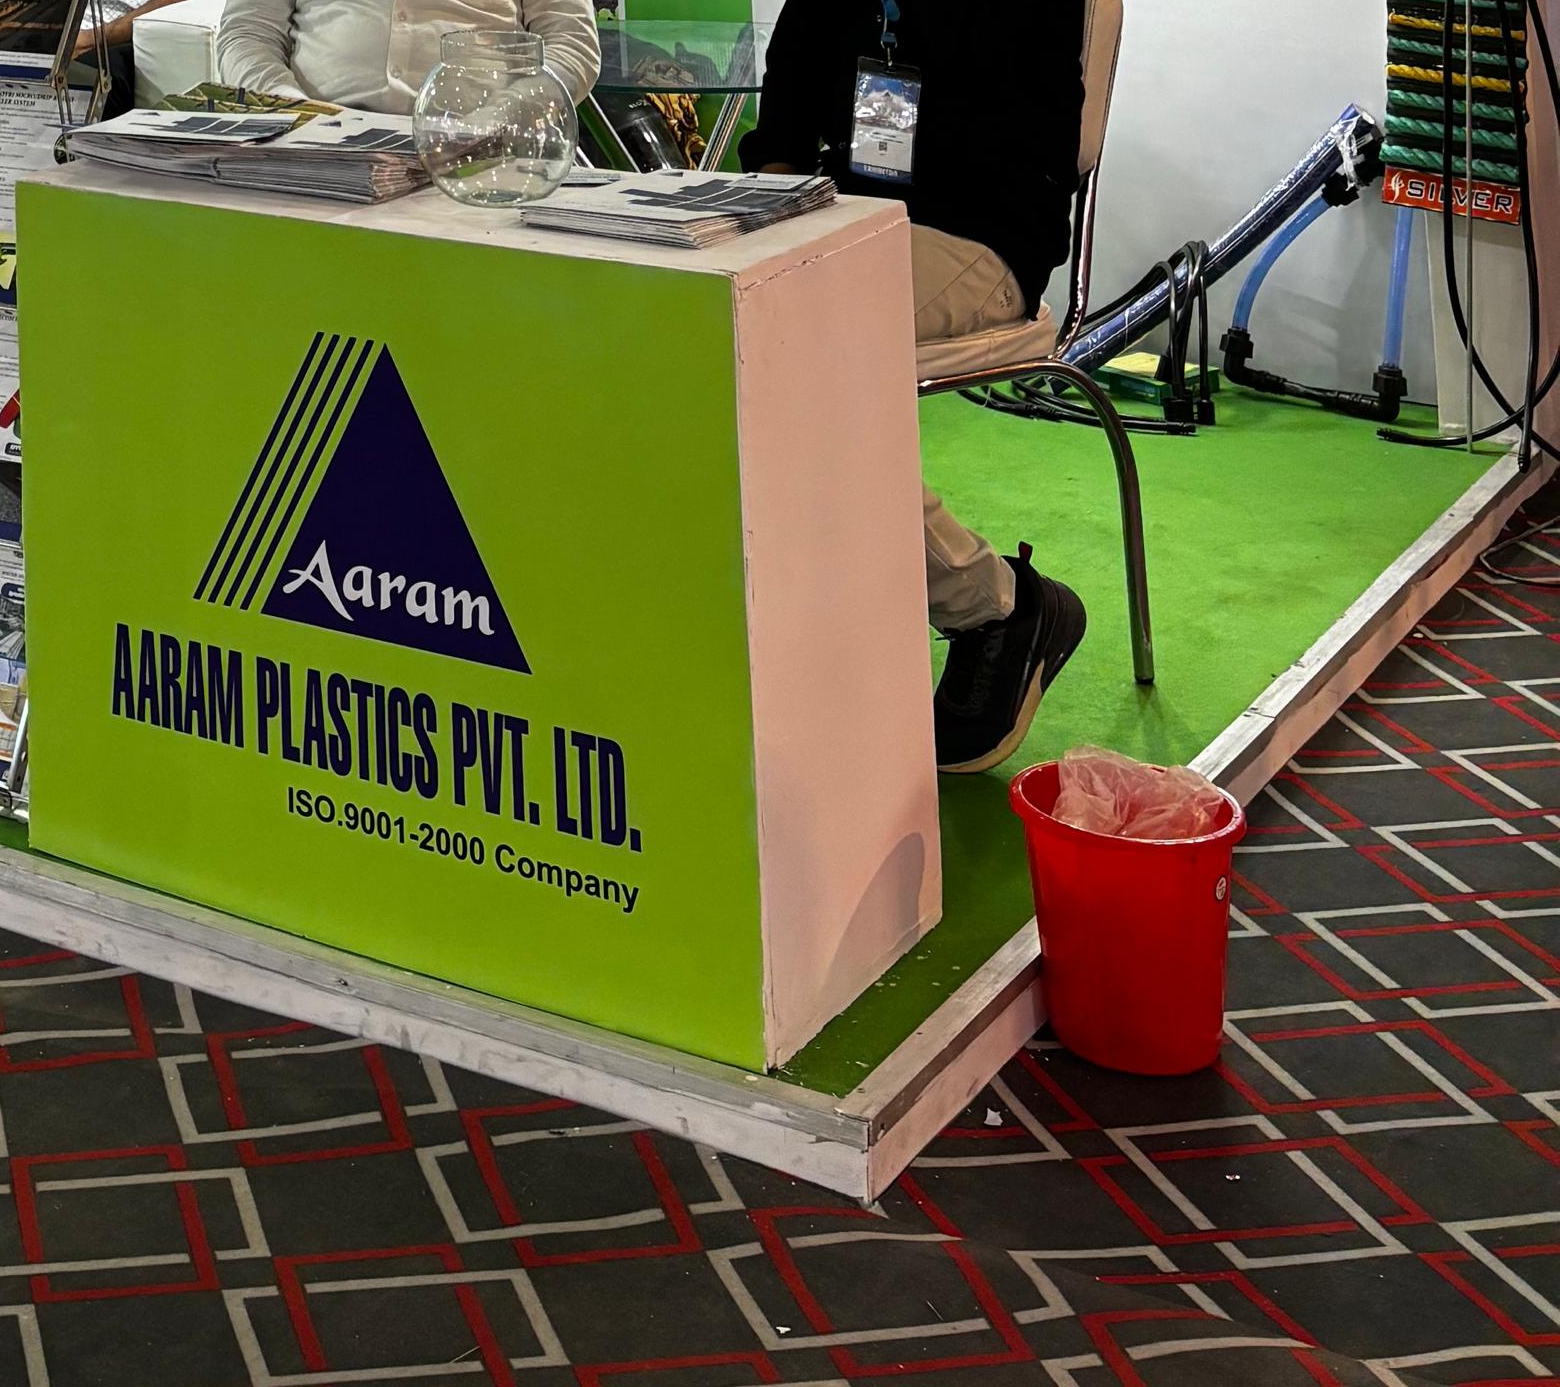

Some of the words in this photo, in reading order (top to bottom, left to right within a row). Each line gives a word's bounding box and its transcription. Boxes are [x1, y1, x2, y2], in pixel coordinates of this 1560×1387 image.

[282, 537, 496, 638] Aaram
[111, 622, 244, 750] AARAM
[256, 657, 439, 801] PLASTICS
[450, 701, 541, 827] PVT.
[554, 727, 643, 853] LTD.
[286, 785, 486, 867] ISO.9001-2000
[494, 843, 639, 915] Company
